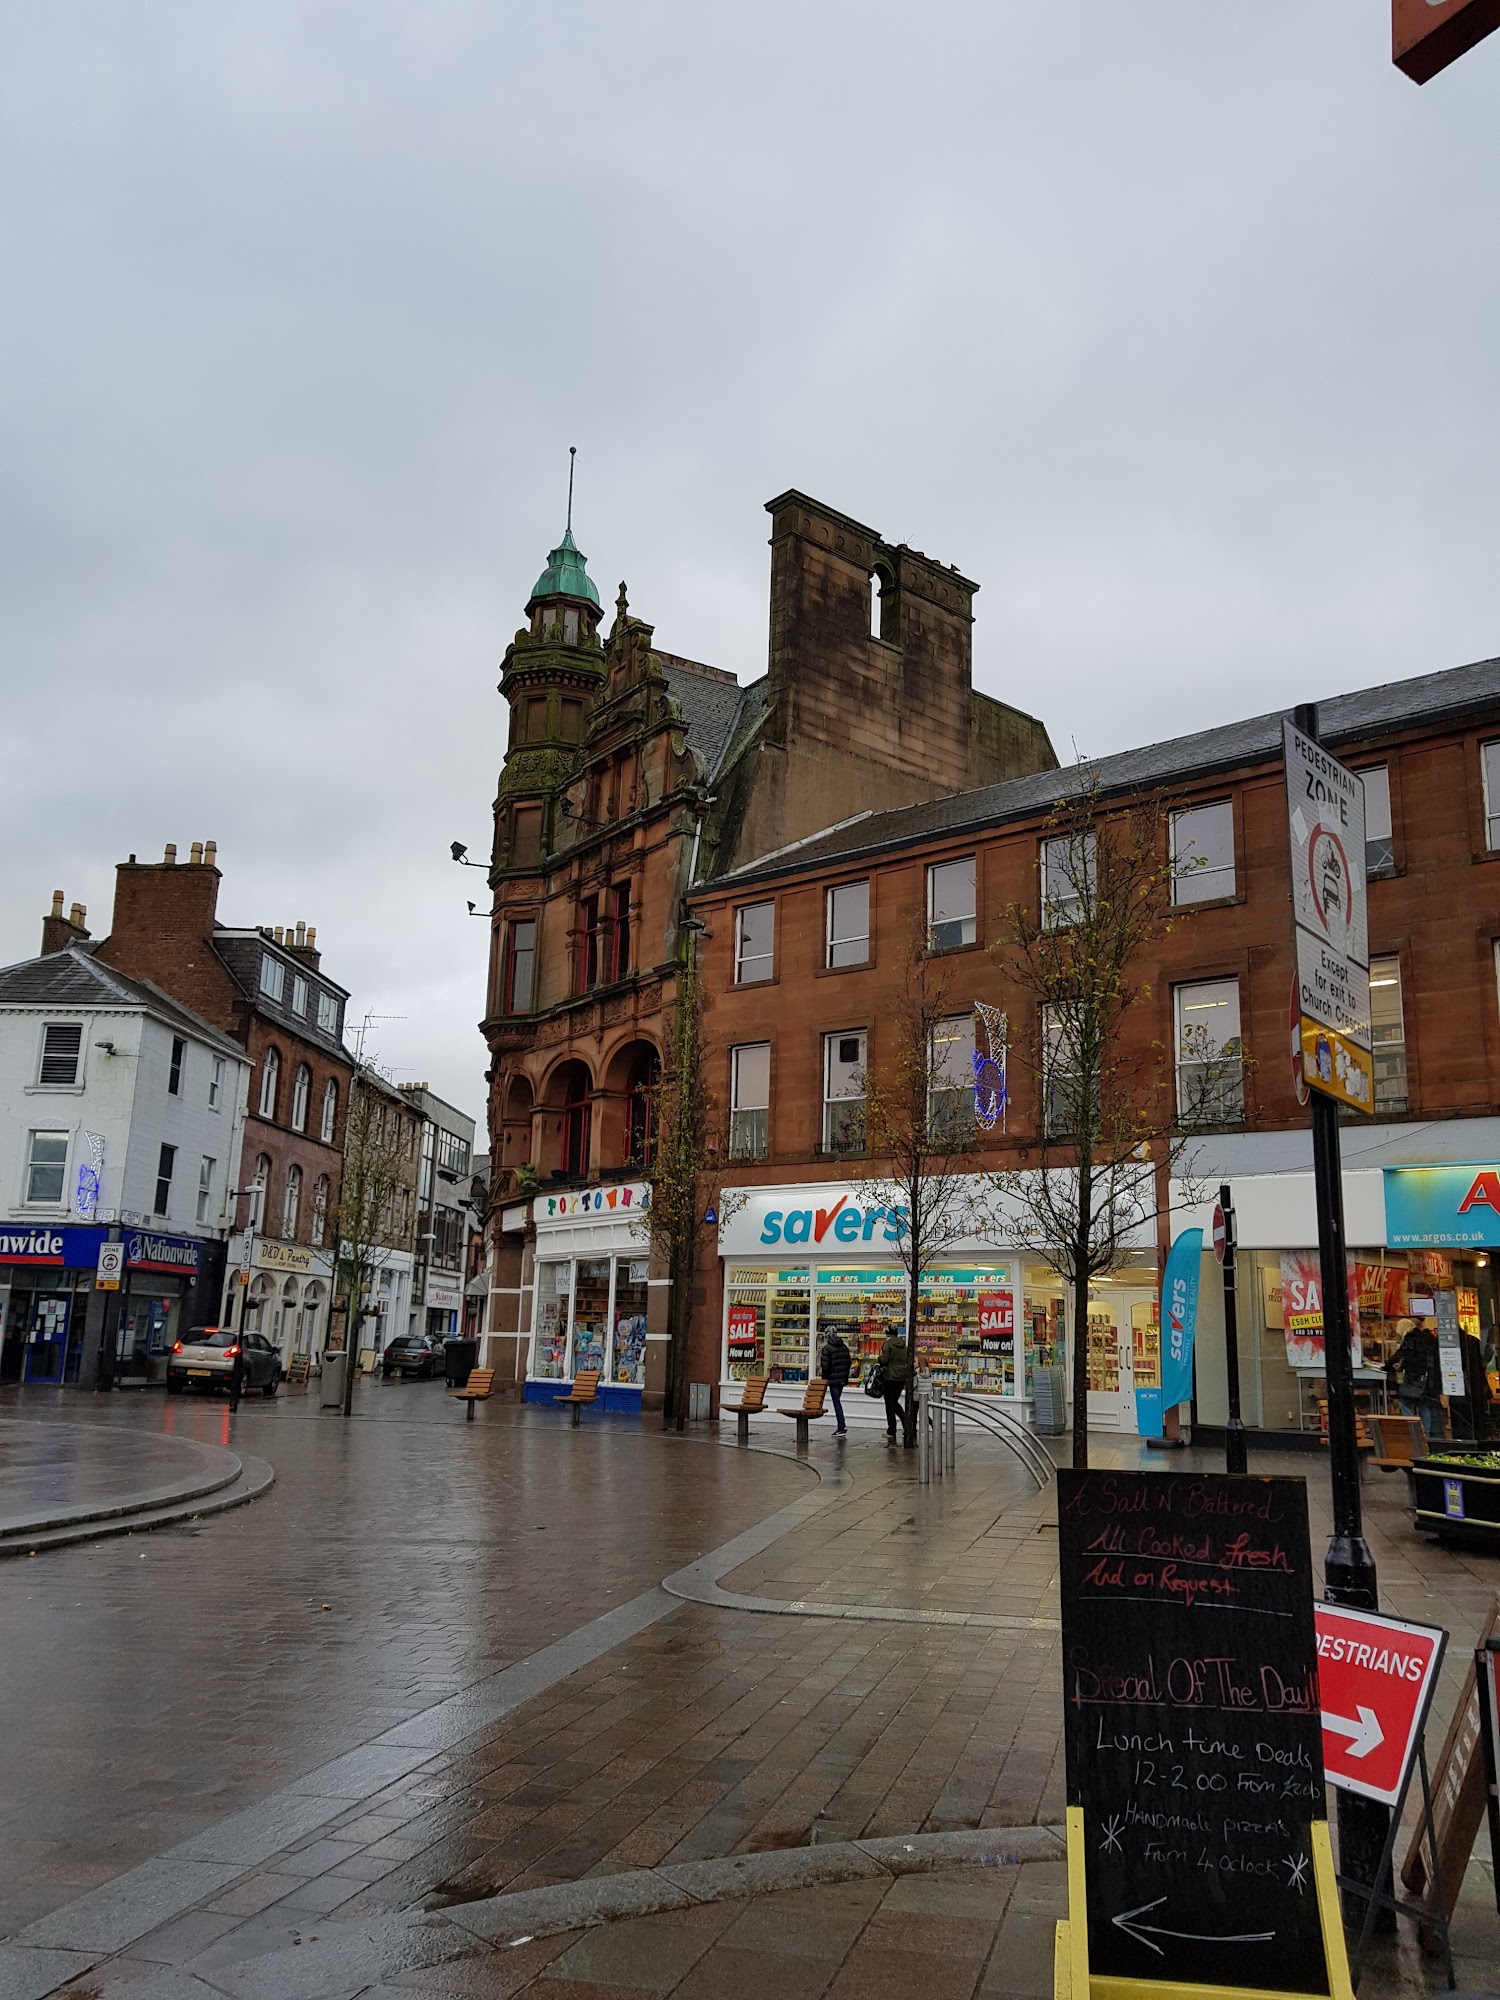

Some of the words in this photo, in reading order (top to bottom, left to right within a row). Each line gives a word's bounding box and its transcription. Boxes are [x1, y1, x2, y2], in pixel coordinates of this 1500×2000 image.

[1295, 734, 1355, 798] PEDESTRIAN
[1305, 769, 1349, 827] ZONE
[1320, 949, 1349, 983] Except
[1315, 969, 1327, 991] for
[1330, 981, 1345, 1001] exit
[1348, 990, 1356, 1009] to
[1302, 985, 1332, 1019] Church
[1335, 1007, 1370, 1041] Crescent
[548, 1187, 633, 1216] TOYTOWN
[760, 1194, 908, 1244] savers
[0, 1230, 63, 1254] nwide
[142, 1236, 198, 1265] Nationwide
[1393, 1231, 1485, 1243] www.argos.co.uk
[287, 1249, 310, 1268] Pantry
[786, 1274, 809, 1283] saver
[830, 1272, 858, 1283] savers
[876, 1272, 905, 1283] savers
[923, 1272, 954, 1283] savers
[973, 1271, 1006, 1283] savers
[1189, 1276, 1197, 1305] BEAUTY
[1362, 1266, 1391, 1291] SALE
[1290, 1280, 1321, 1311] SA
[730, 1322, 755, 1339] SALE
[981, 1310, 1013, 1330] SALE
[1167, 1278, 1186, 1361] savers
[1187, 1311, 1195, 1334] HOME
[1312, 1315, 1323, 1324] CLE
[729, 1347, 744, 1358] Now
[744, 1347, 755, 1357] on!
[983, 1339, 1000, 1350] Now
[1001, 1340, 1014, 1350] on!
[1087, 1524, 1126, 1551] All
[1139, 1527, 1211, 1561] Cooked
[1082, 1557, 1125, 1588] And
[1134, 1572, 1154, 1587] on
[1161, 1564, 1240, 1606] Request
[1168, 1658, 1206, 1704] Of
[1204, 1658, 1258, 1706] The
[1097, 1715, 1174, 1753] Lunch
[1182, 1728, 1244, 1759] time
[1256, 1743, 1312, 1768] Deals
[1237, 1773, 1275, 1792] From
[1144, 1843, 1187, 1862] From
[1197, 1847, 1214, 1872] 4
